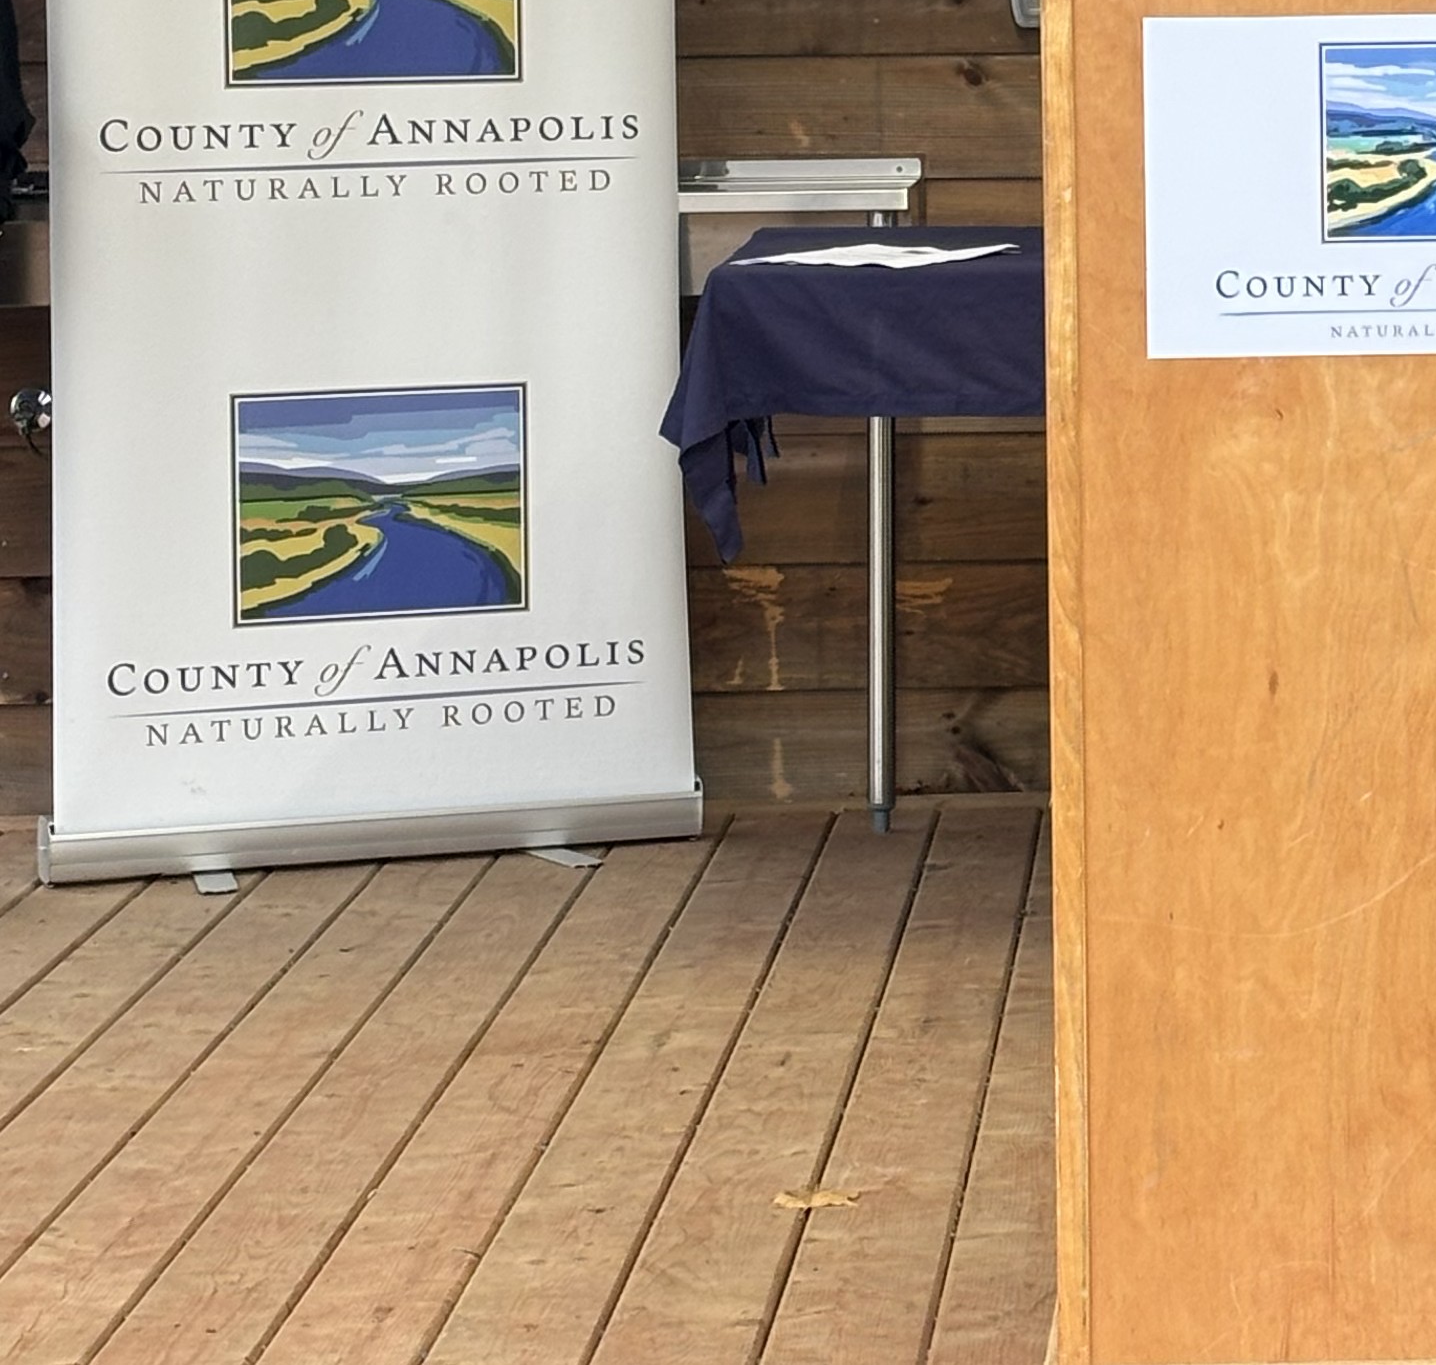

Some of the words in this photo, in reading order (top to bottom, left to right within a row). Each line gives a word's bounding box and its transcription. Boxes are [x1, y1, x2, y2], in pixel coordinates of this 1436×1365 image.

[99, 118, 298, 154] COUNTY
[307, 109, 364, 160] of
[367, 113, 641, 146] ANNAPOLIS
[139, 174, 409, 205] NATURALLY
[437, 168, 613, 195] ROOTED
[1215, 268, 1383, 300] COUNTY
[107, 659, 306, 698] COUNTY
[314, 644, 372, 697] of
[374, 639, 646, 682] ANNAPOLIS
[145, 707, 418, 748] NATURALLY
[442, 694, 618, 728] ROOTED
